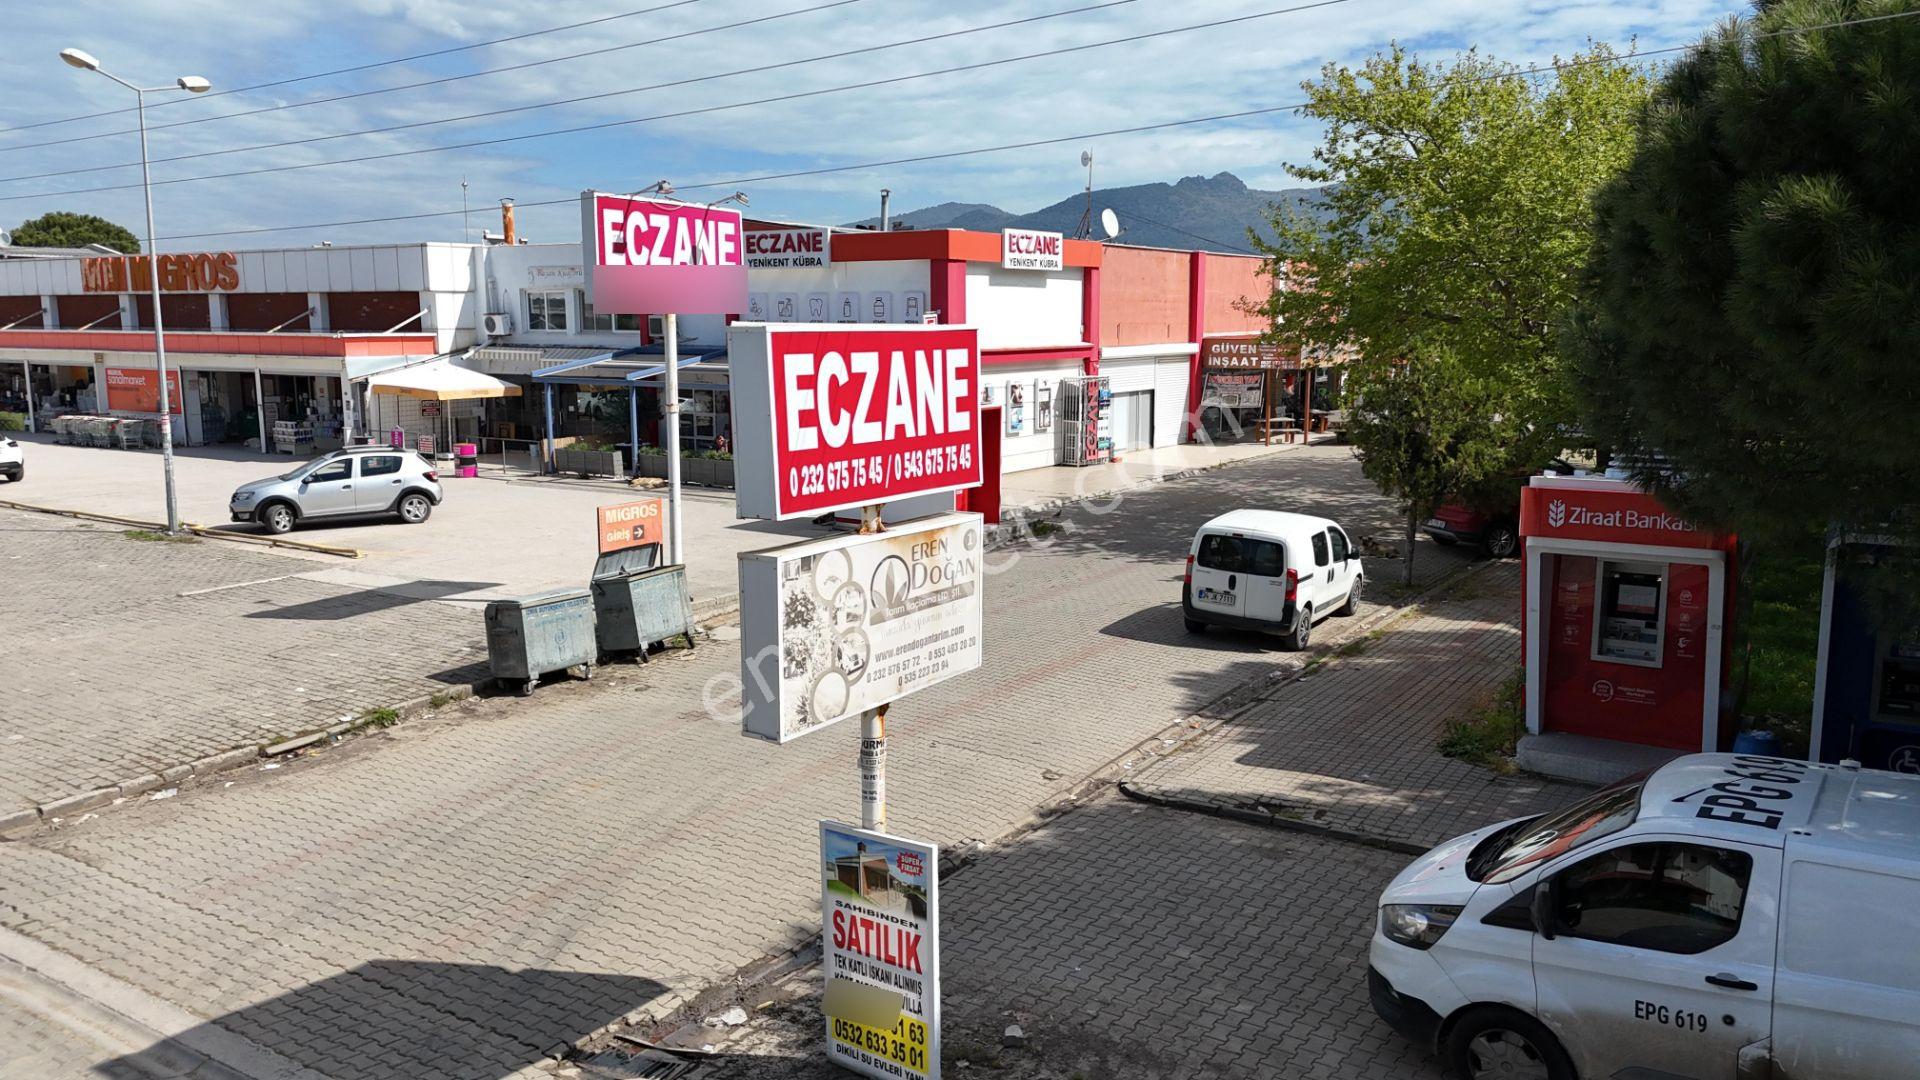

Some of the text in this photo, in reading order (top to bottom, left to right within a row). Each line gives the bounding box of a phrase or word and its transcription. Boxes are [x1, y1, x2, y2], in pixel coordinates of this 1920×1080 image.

[602, 208, 737, 265] ECZANE
[745, 232, 823, 254] ECZANE
[1008, 233, 1060, 255] ECZANE
[748, 256, 823, 267] YENİKENT KÜBRA
[1208, 356, 1259, 368] İNŞAAT
[1211, 342, 1257, 354] GÜVEN
[783, 348, 971, 452] ECZANE
[1084, 380, 1098, 460] ECZANE
[789, 466, 798, 498] 0
[801, 463, 825, 495] 232
[827, 460, 850, 492] 675
[851, 457, 867, 487] 75
[868, 455, 883, 484] 45
[894, 453, 902, 480] 0
[904, 450, 923, 479] 543
[925, 447, 943, 475] 675
[945, 445, 958, 472] 75
[959, 443, 972, 470] 45
[1568, 507, 1622, 528] Ziraat
[911, 537, 948, 562] EREN
[1695, 756, 1809, 830] EPG 619
[832, 909, 923, 975] SATILIK
[833, 953, 848, 970] TEK
[848, 958, 868, 977] KATLI
[869, 960, 892, 985] İSKANI
[893, 973, 923, 999] ALINMIŞ
[1634, 999, 1707, 1033] EPG 619
[834, 1018, 924, 1069] 0532 633 35 01
[909, 1022, 924, 1045] 63
[836, 1043, 859, 1060] DİKİLİ
[861, 1052, 872, 1065] SU
[874, 1057, 903, 1078] EVLERİ
